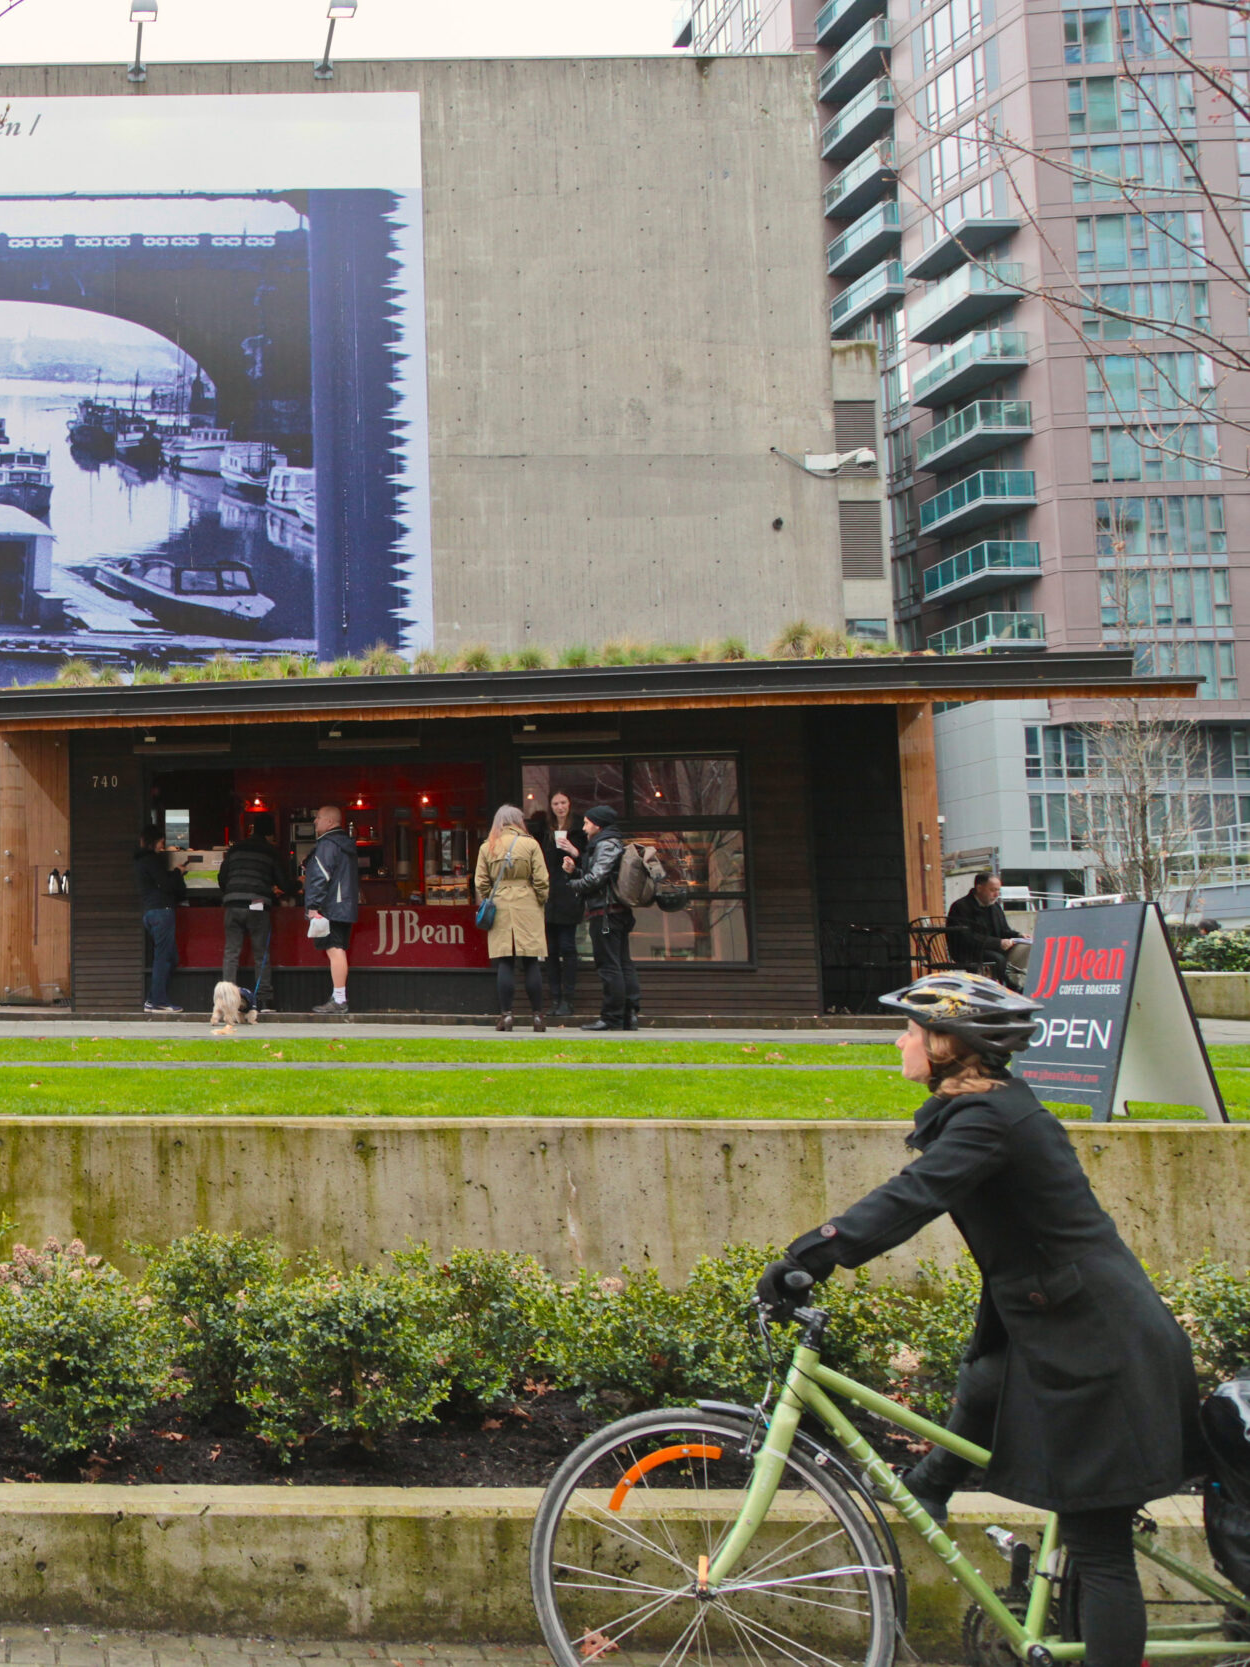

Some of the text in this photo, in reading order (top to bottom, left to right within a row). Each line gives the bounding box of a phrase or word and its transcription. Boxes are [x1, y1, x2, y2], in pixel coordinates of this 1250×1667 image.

[92, 775, 118, 788] 740
[1059, 984, 1121, 995] COFFEE ROASTERS
[1029, 1017, 1113, 1049] OPEN
